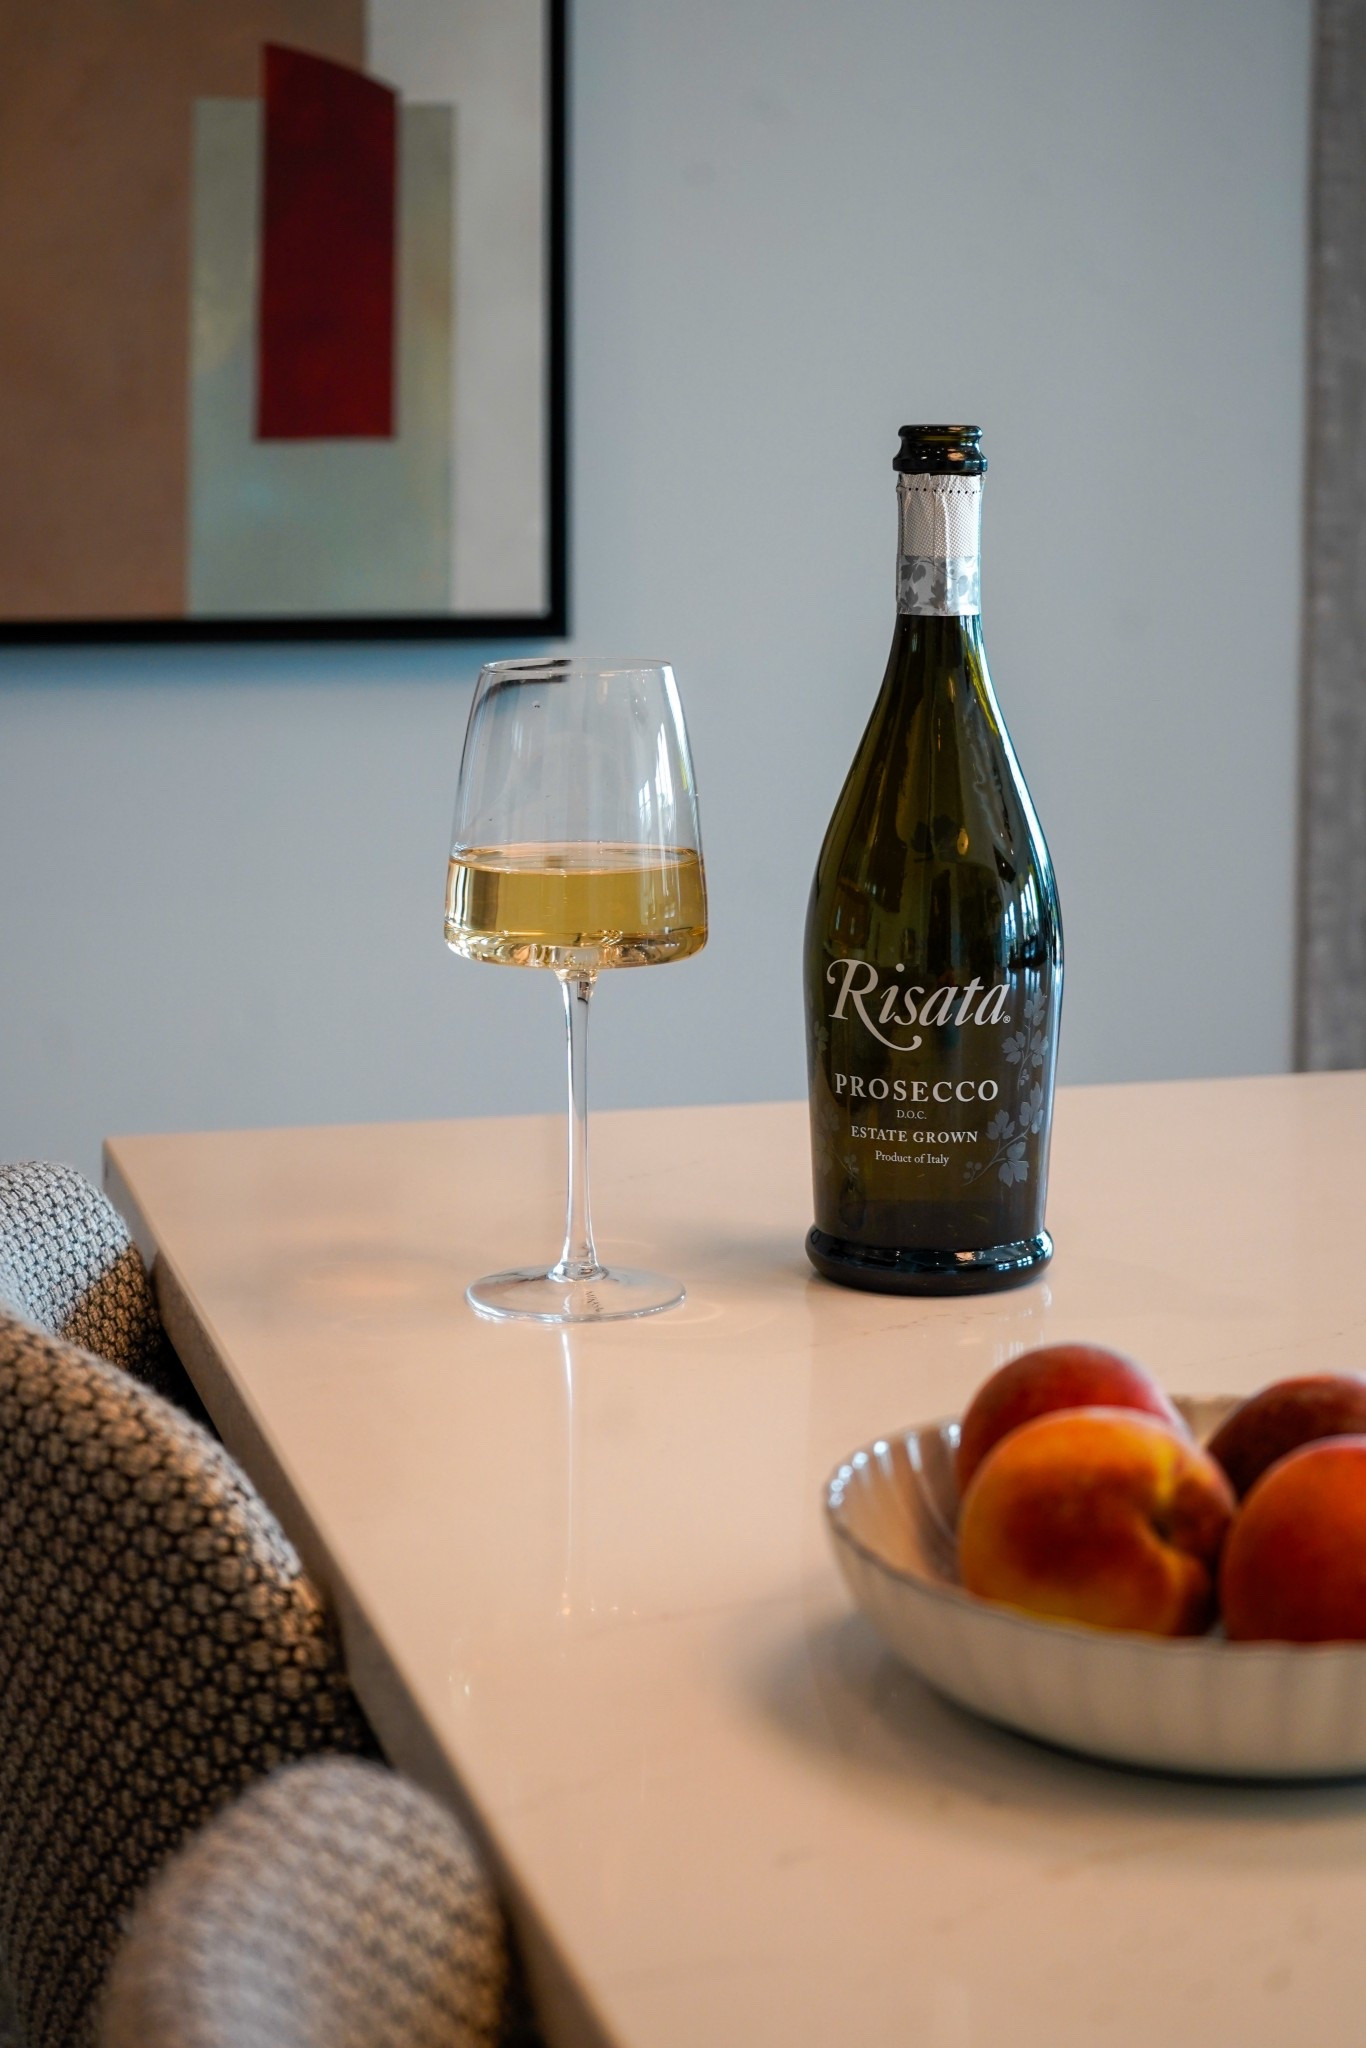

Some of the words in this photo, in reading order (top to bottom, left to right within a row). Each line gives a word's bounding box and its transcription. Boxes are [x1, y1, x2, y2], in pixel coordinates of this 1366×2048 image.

[826, 958, 1011, 1052] Risata
[835, 1073, 998, 1102] PROSECCO
[896, 1109, 927, 1120] D.O.C.
[851, 1125, 908, 1143] ESTATE
[912, 1131, 978, 1144] GROWN
[875, 1150, 912, 1164] Product
[914, 1153, 926, 1164] of
[927, 1154, 949, 1167] Italy
